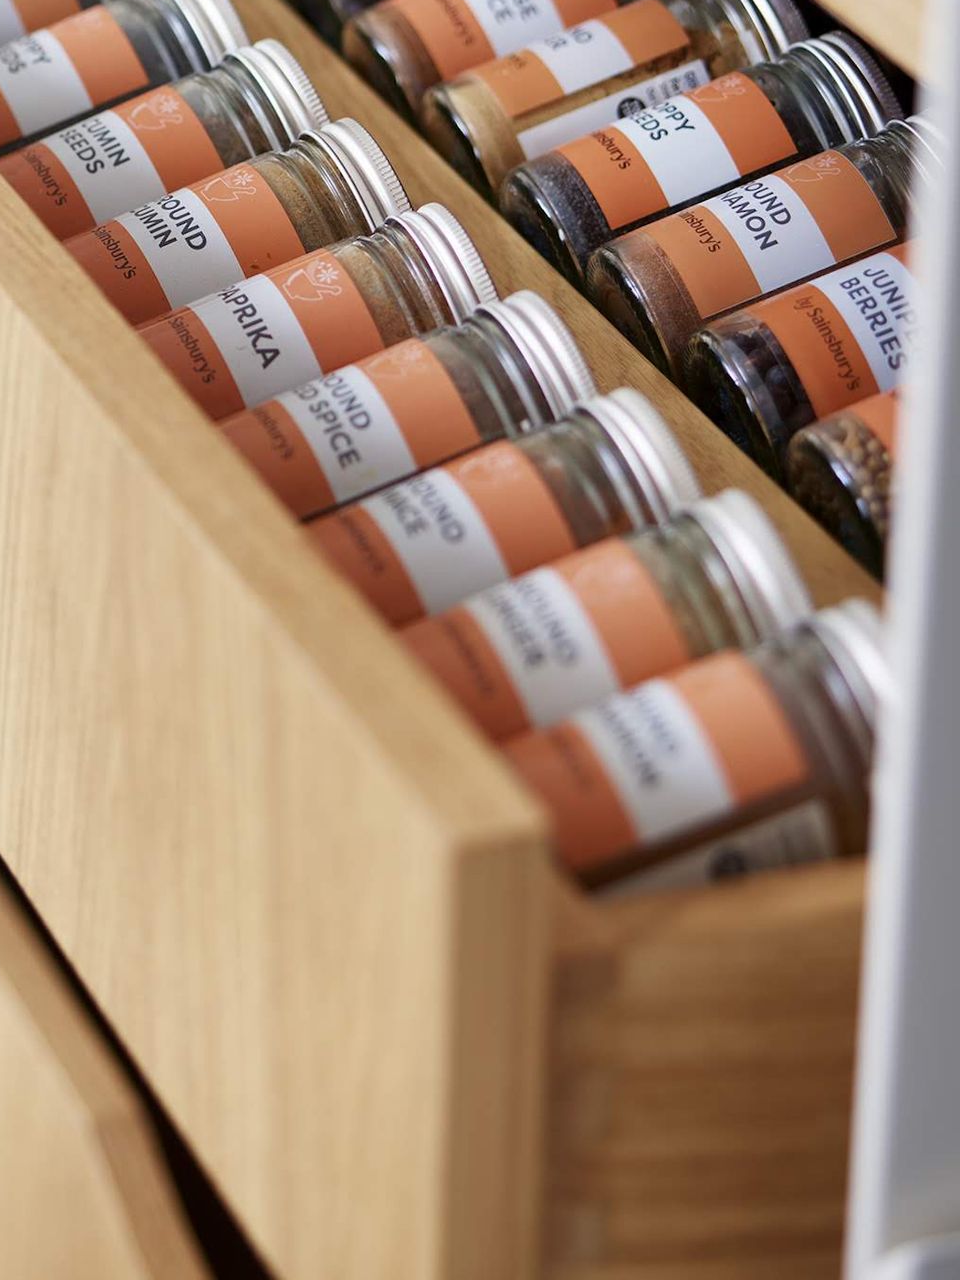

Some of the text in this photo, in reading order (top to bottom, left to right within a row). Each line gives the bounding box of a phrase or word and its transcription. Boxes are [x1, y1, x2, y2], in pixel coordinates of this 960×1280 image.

[740, 179, 793, 226] OUND
[806, 307, 861, 392] Sainsbury's
[839, 276, 908, 371] BERRIES
[321, 373, 372, 431] OUND
